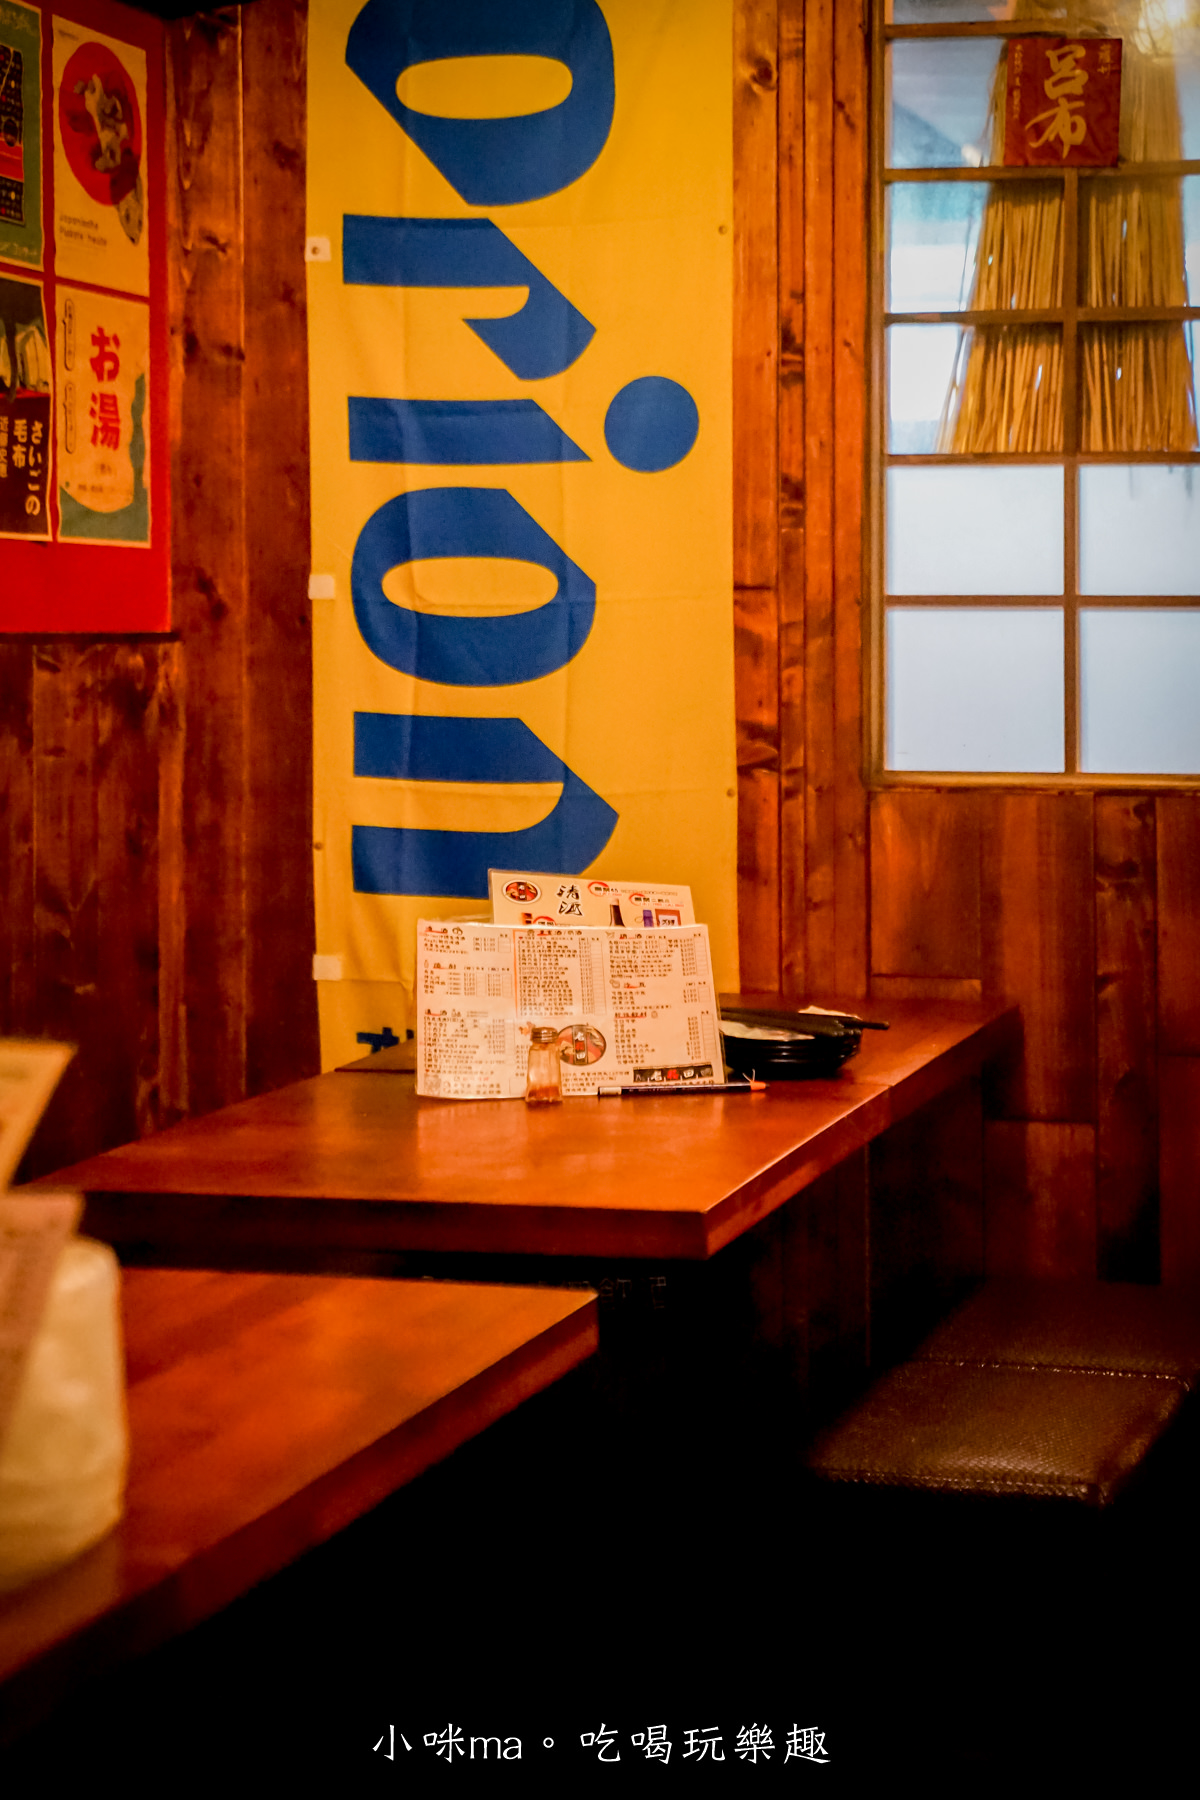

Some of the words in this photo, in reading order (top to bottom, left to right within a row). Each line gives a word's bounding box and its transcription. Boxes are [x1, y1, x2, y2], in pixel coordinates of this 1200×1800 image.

[1025, 44, 1089, 160] 呂布
[12, 418, 28, 468] 毛布
[89, 326, 121, 451] お湯
[25, 419, 43, 516] さいごの
[343, 0, 700, 899] Orion
